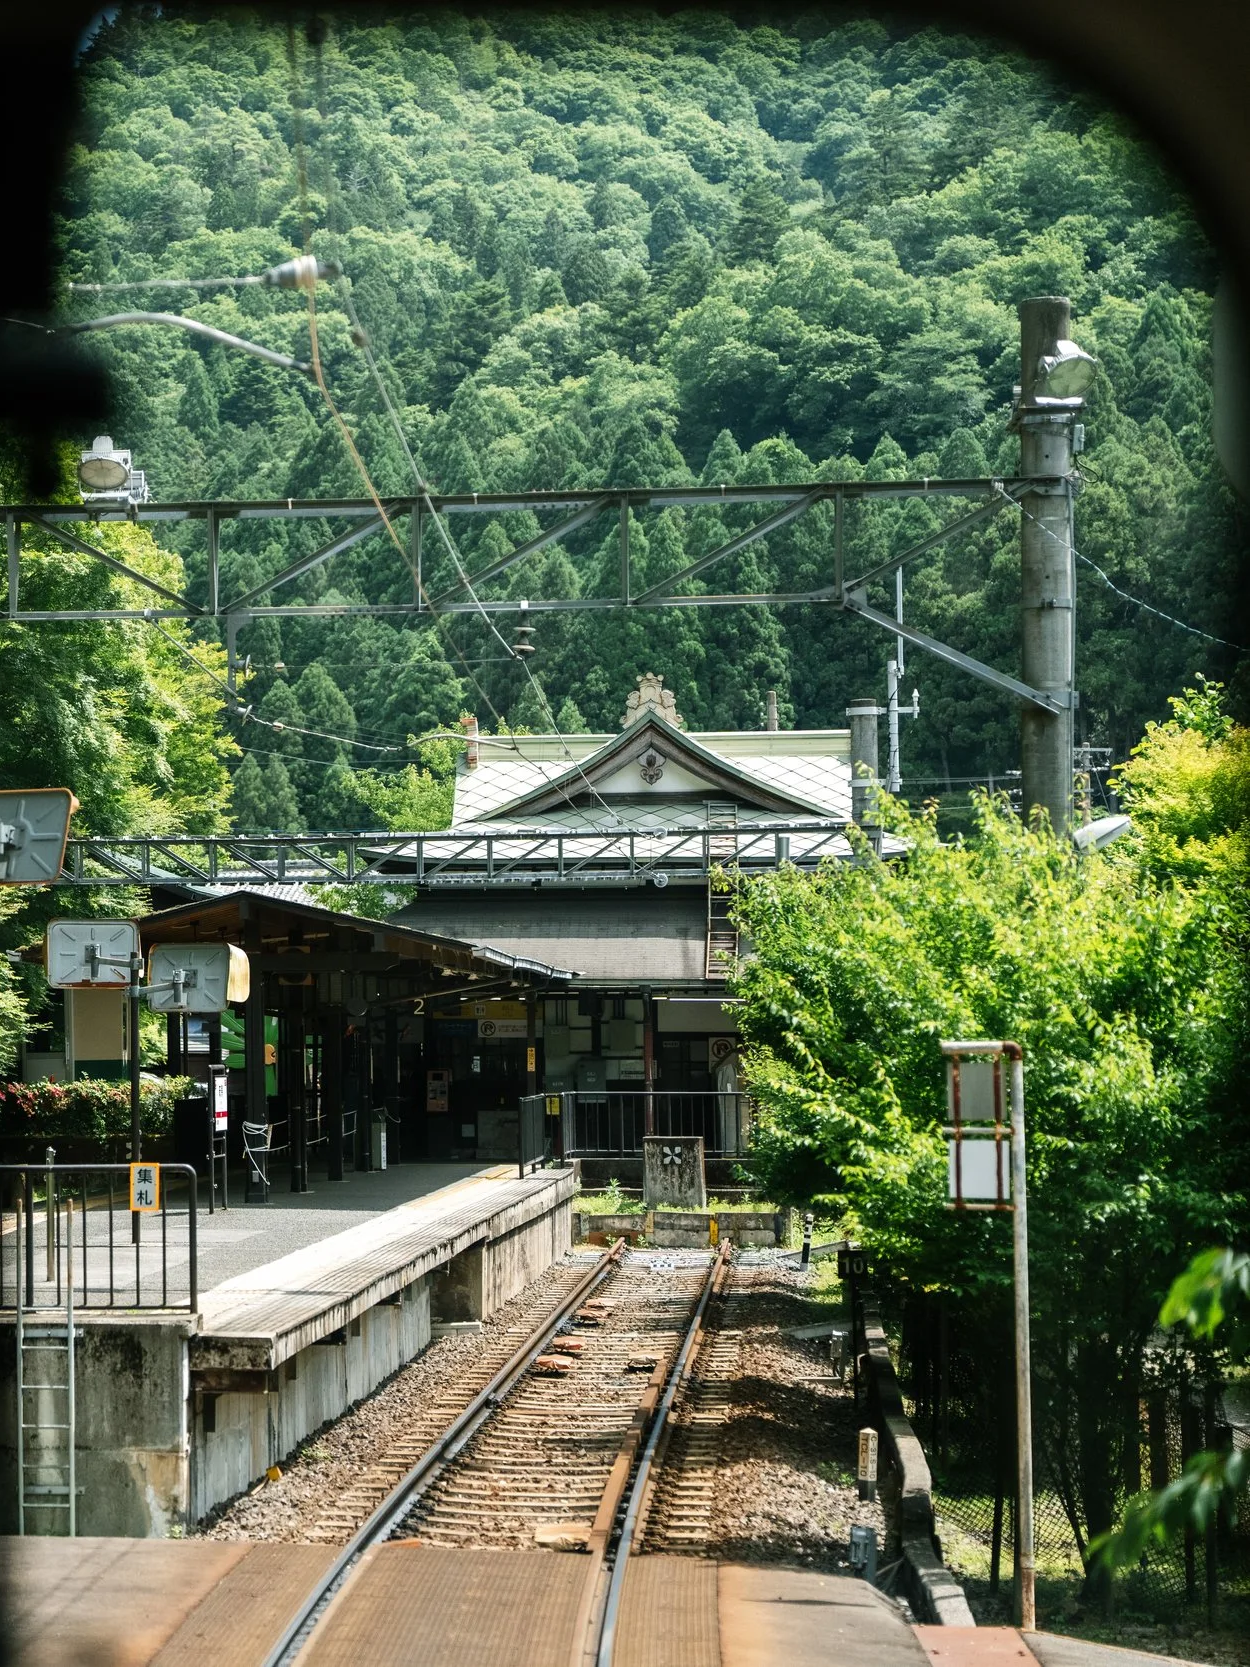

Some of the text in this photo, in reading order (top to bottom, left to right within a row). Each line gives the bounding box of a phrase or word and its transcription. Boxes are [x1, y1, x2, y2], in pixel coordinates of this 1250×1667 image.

[413, 998, 425, 1015] 2
[136, 1168, 153, 1206] 集札
[838, 1256, 864, 1275] 10
[860, 1436, 869, 1477] TCL-10
